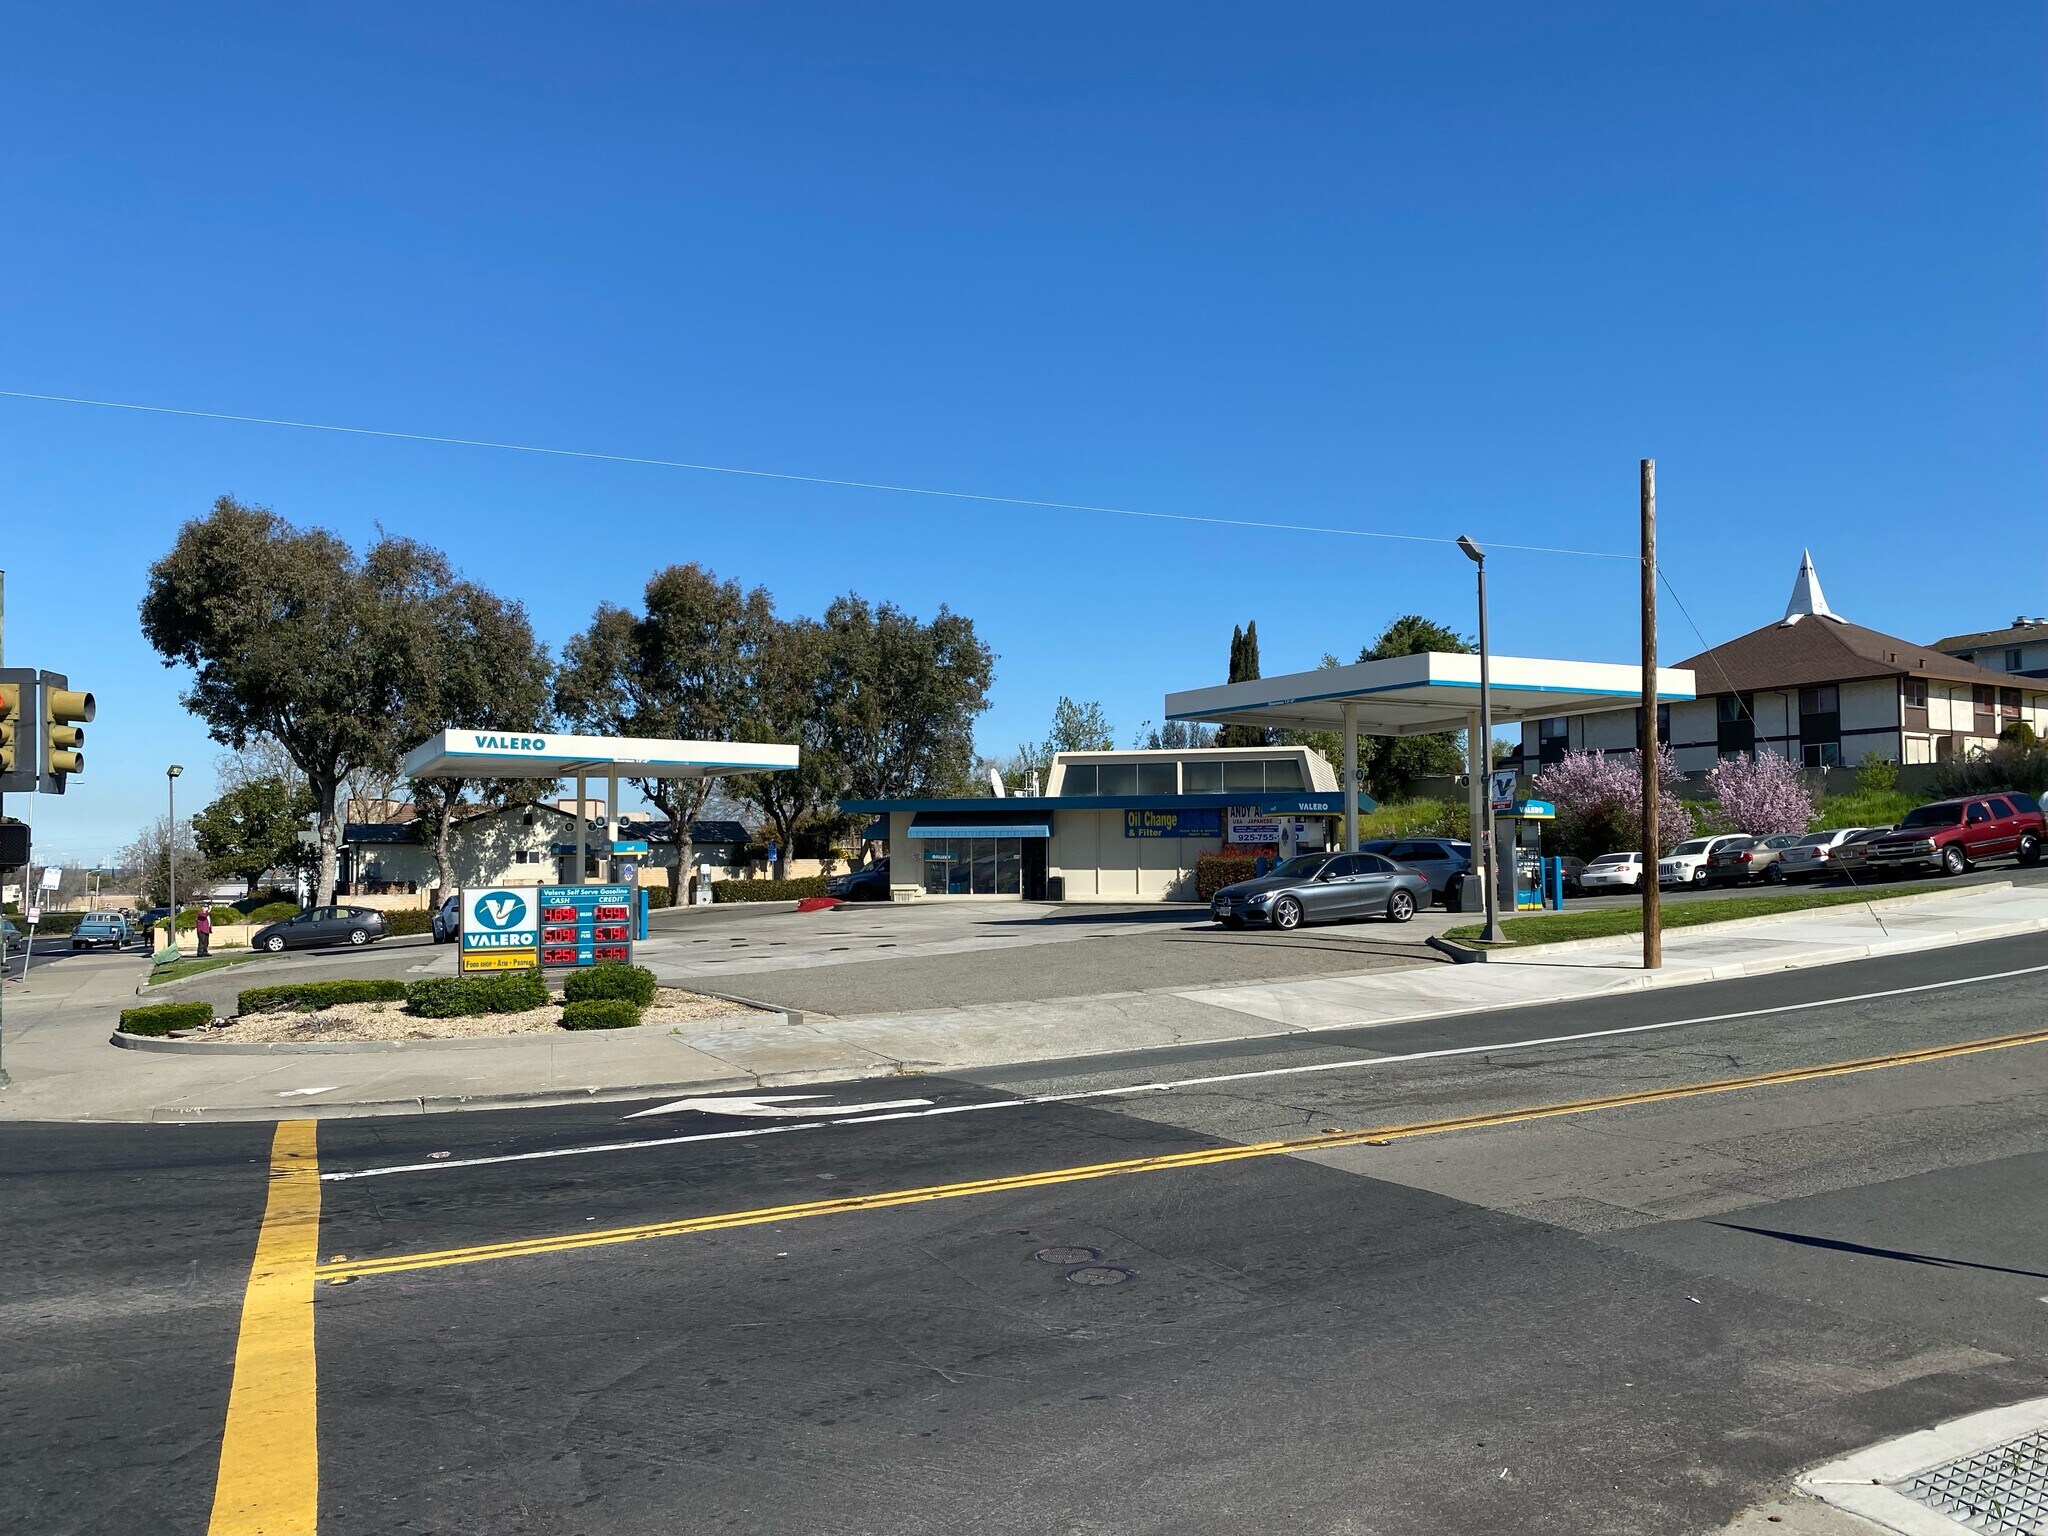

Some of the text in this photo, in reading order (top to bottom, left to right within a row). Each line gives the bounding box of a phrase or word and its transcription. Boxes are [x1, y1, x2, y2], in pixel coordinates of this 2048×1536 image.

[475, 735, 546, 751] VALERO
[1230, 806, 1251, 818] ANDY
[1298, 802, 1328, 811] VALERO
[1518, 806, 1544, 814] VALERO
[1128, 811, 1178, 831] Oil Change
[1128, 829, 1162, 837] & Filter
[467, 933, 534, 947] VALERO
